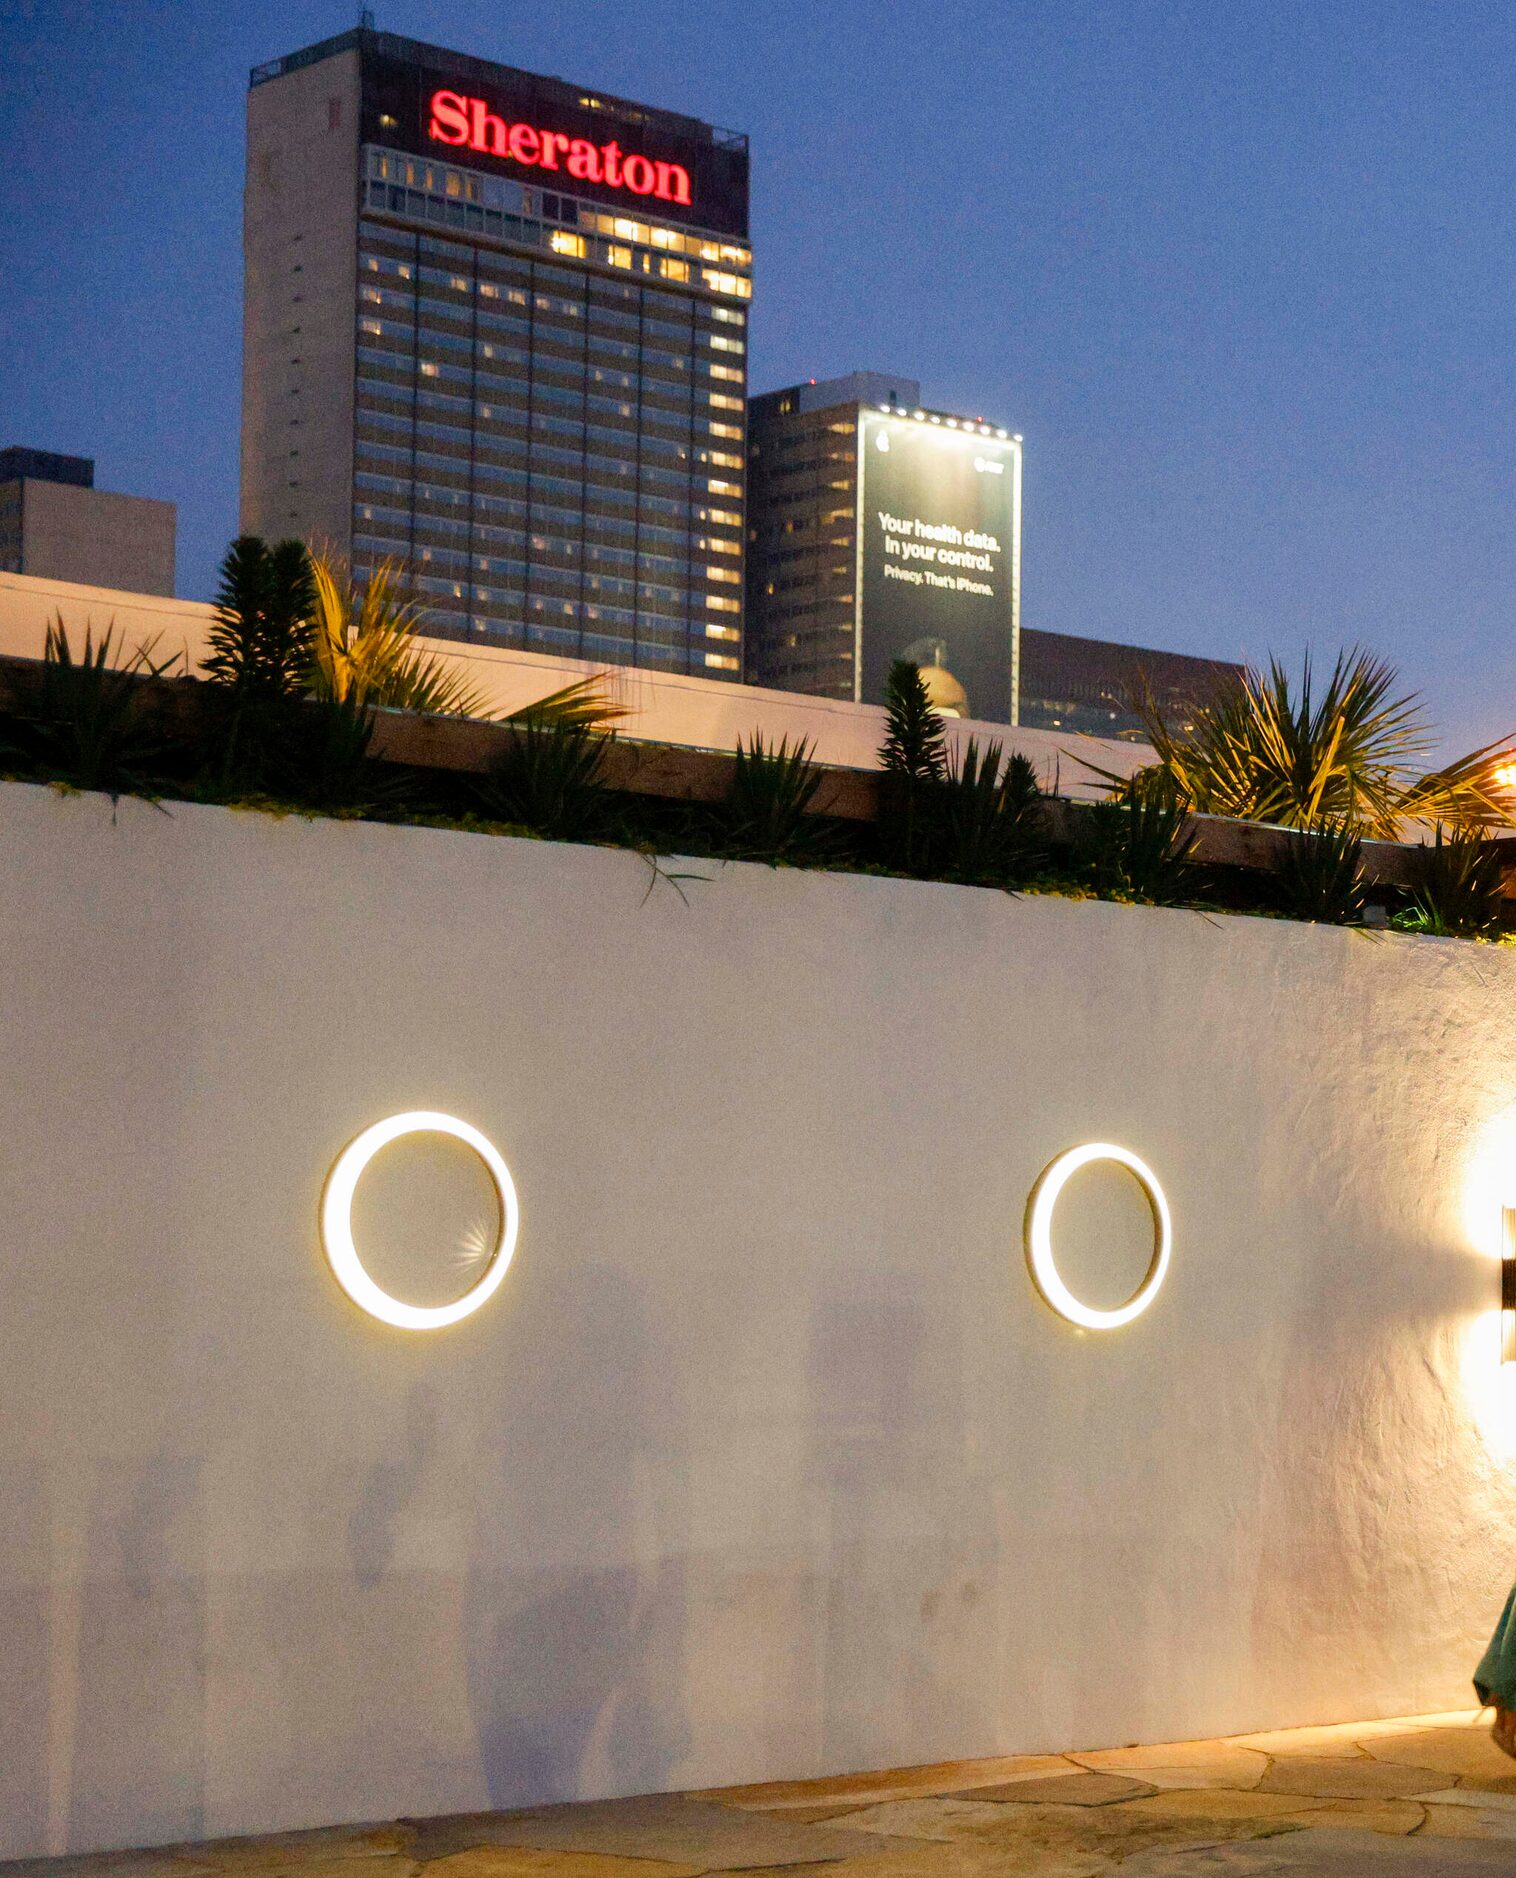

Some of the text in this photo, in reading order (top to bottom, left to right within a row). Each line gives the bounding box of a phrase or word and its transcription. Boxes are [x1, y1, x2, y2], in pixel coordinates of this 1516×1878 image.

[430, 89, 692, 206] Sheraton
[878, 511, 1001, 553] Your health data.
[884, 535, 994, 572] In your control.
[884, 564, 994, 597] Privacy. That's iPhone.
